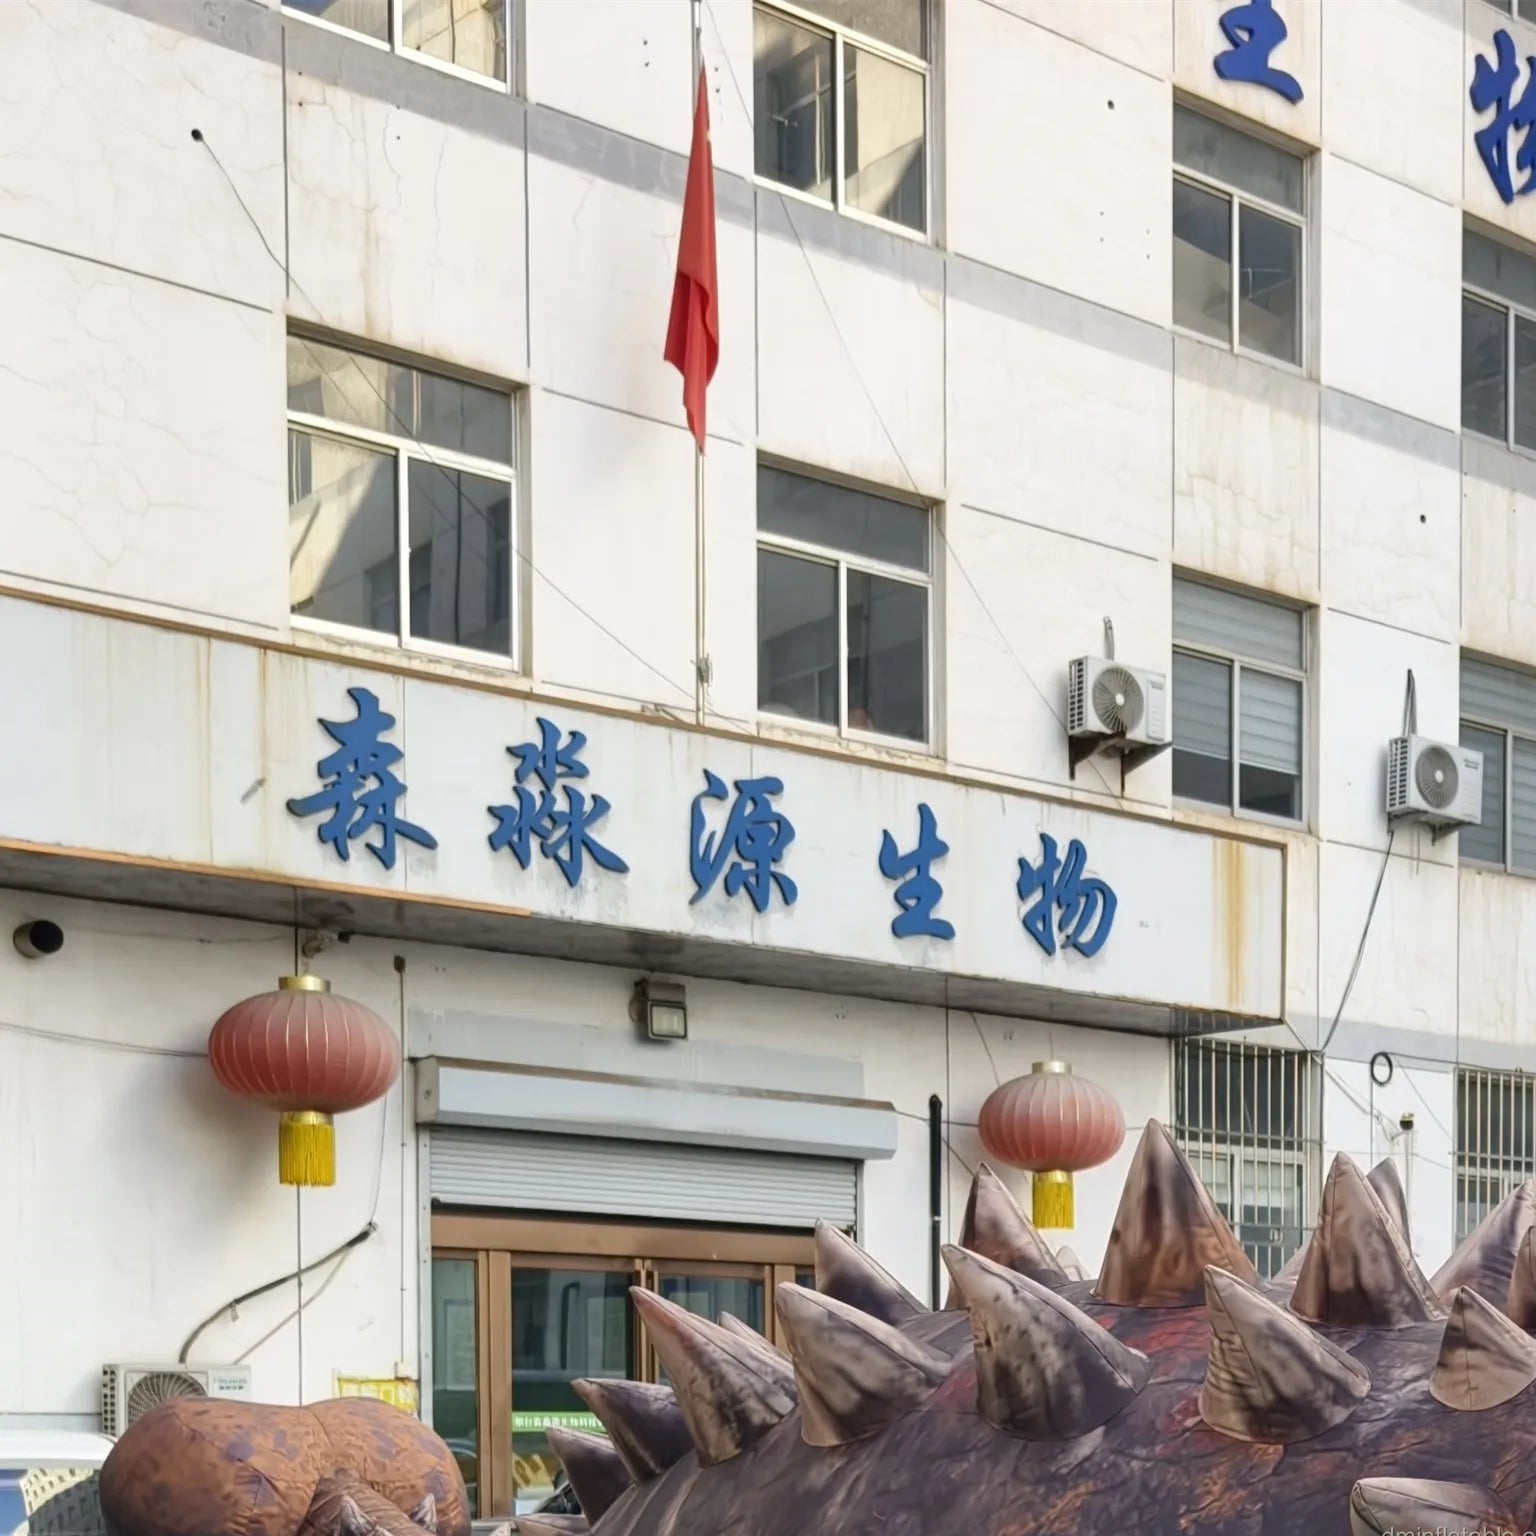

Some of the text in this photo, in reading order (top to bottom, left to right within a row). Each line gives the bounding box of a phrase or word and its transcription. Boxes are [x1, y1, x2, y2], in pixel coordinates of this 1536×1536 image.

[287, 687, 1117, 960] 森淼源生物
